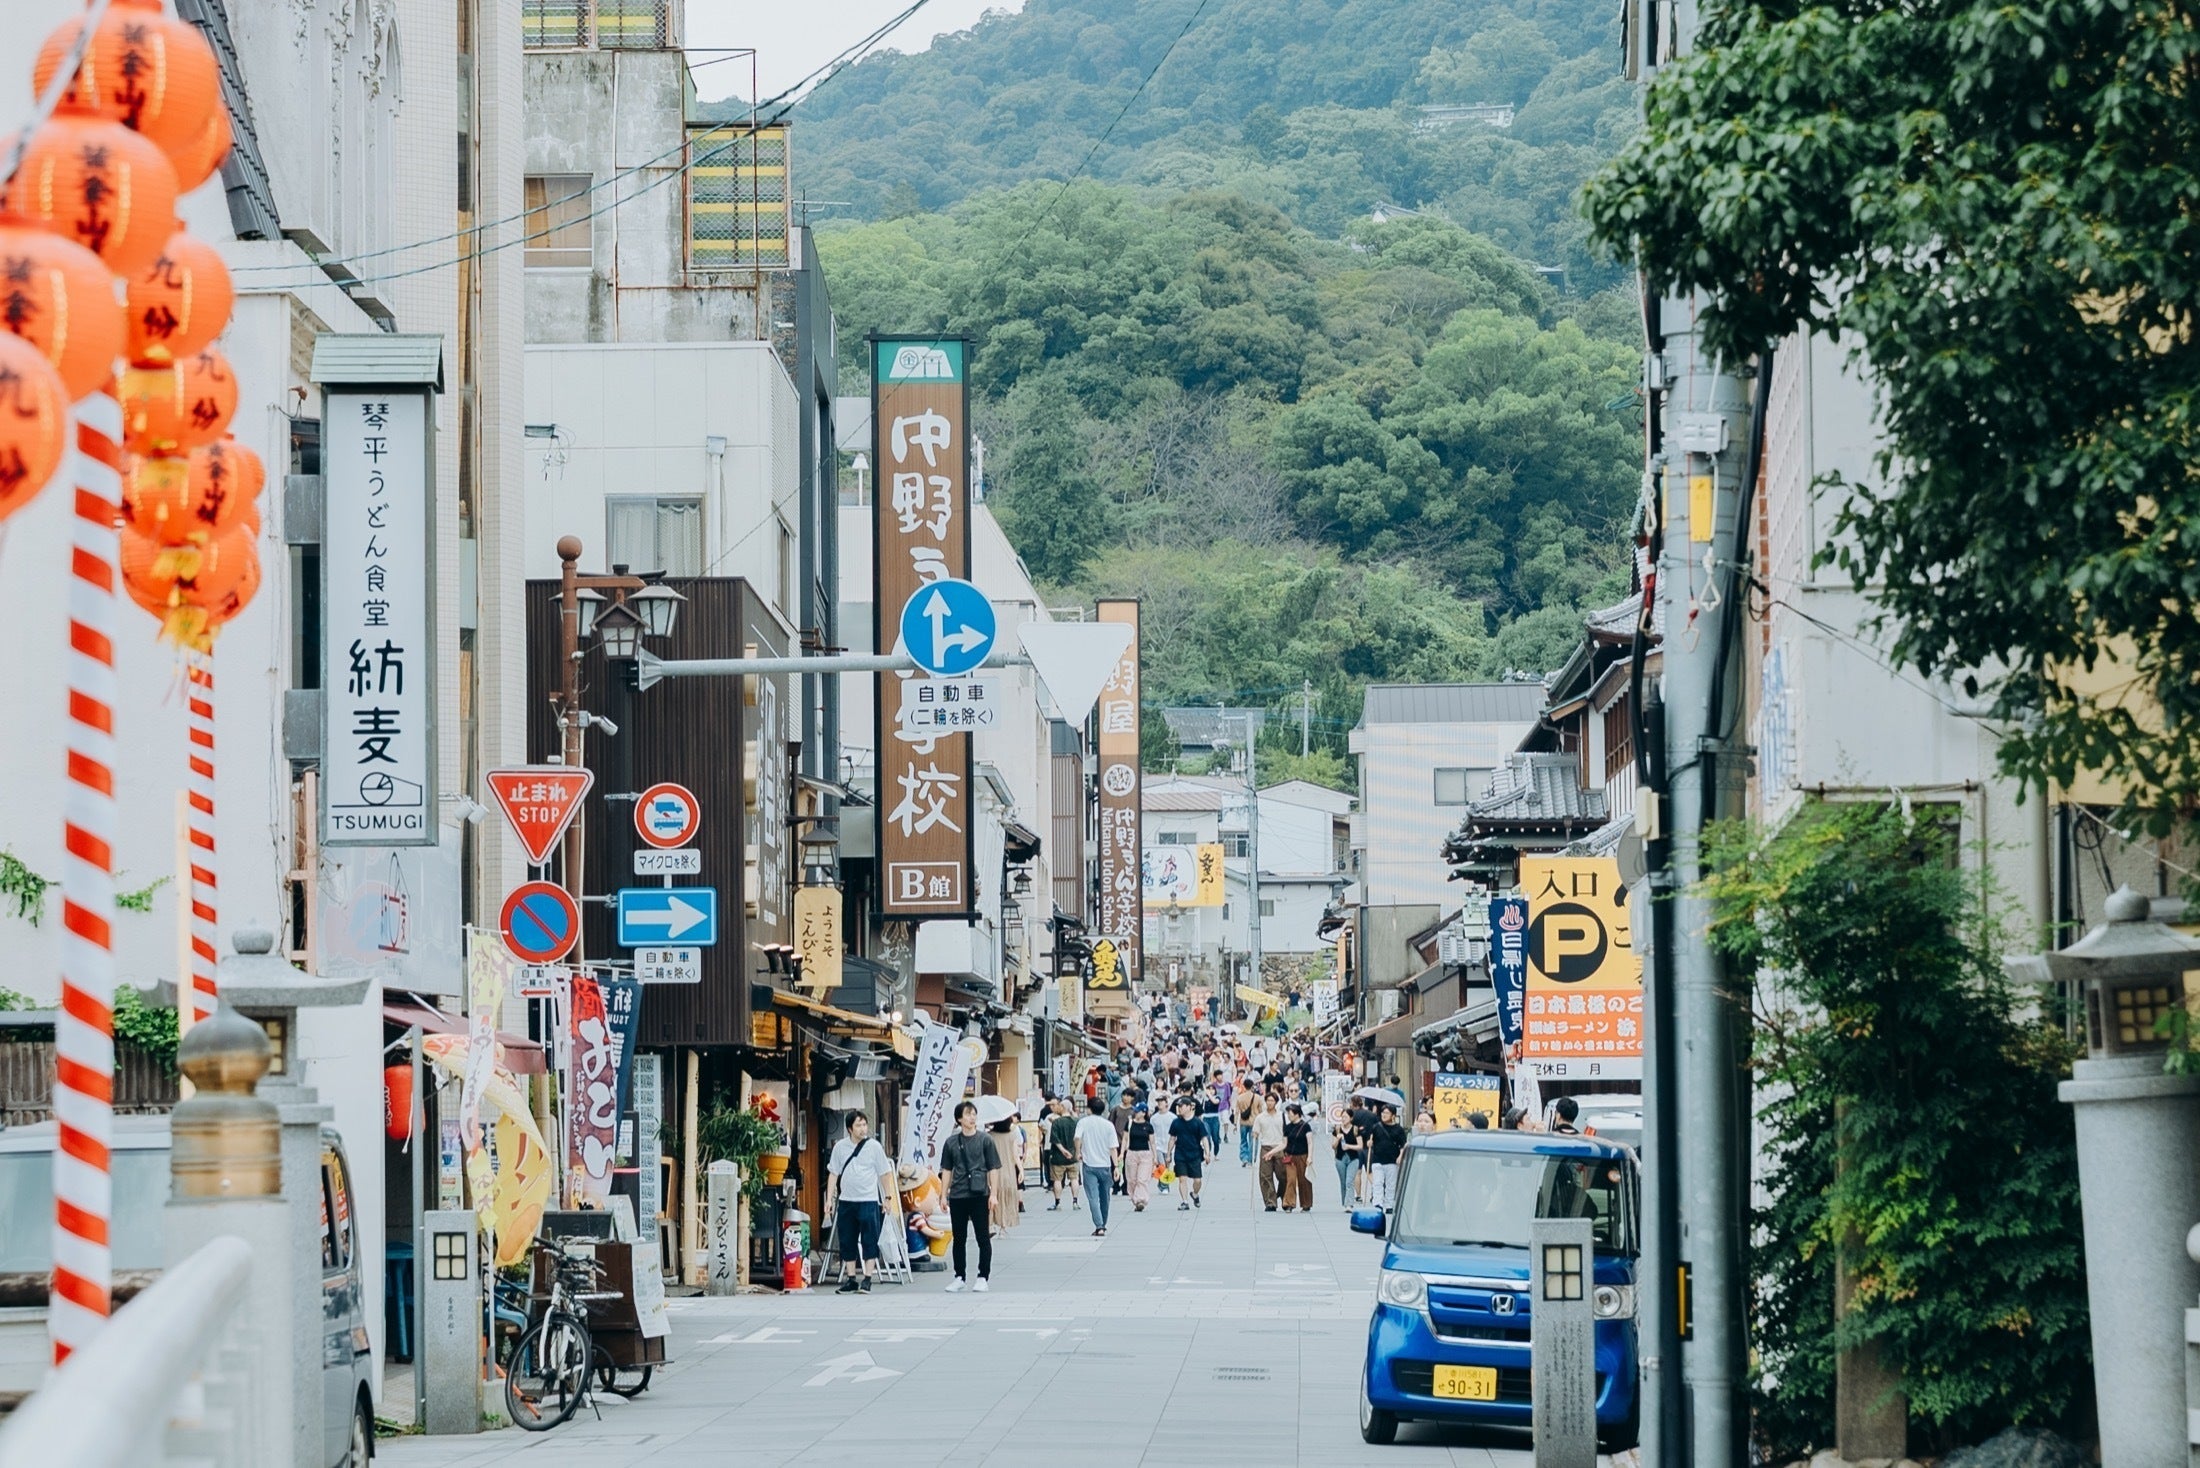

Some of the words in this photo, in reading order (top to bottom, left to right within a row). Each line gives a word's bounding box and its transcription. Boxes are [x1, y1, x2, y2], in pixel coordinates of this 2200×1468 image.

[360, 402, 391, 627] 琴平うどん食堂
[348, 637, 405, 765] 紡麦
[918, 684, 986, 703] 自動車
[909, 707, 994, 727] (二輪を除く)
[508, 782, 568, 803] 止まれ
[331, 814, 424, 830] TSUMUGI
[519, 806, 560, 824] STOP
[1102, 807, 1114, 856] Nakano
[638, 855, 698, 870] マイクロを除く
[1102, 858, 1114, 893] Udon
[1115, 807, 1139, 938] 中野うどん学校
[899, 868, 952, 901] B館
[1535, 868, 1598, 901] 入口
[1102, 896, 1114, 935] Schoo
[821, 905, 836, 958] ようこそ
[1543, 914, 1600, 973] P
[645, 951, 691, 964] 自動車
[521, 968, 545, 978] 自動
[1437, 1076, 1465, 1089] この先
[1589, 1063, 1601, 1076] 月
[913, 1035, 953, 1164] 小豆島そうめ
[1448, 1379, 1490, 1398] 90-31
